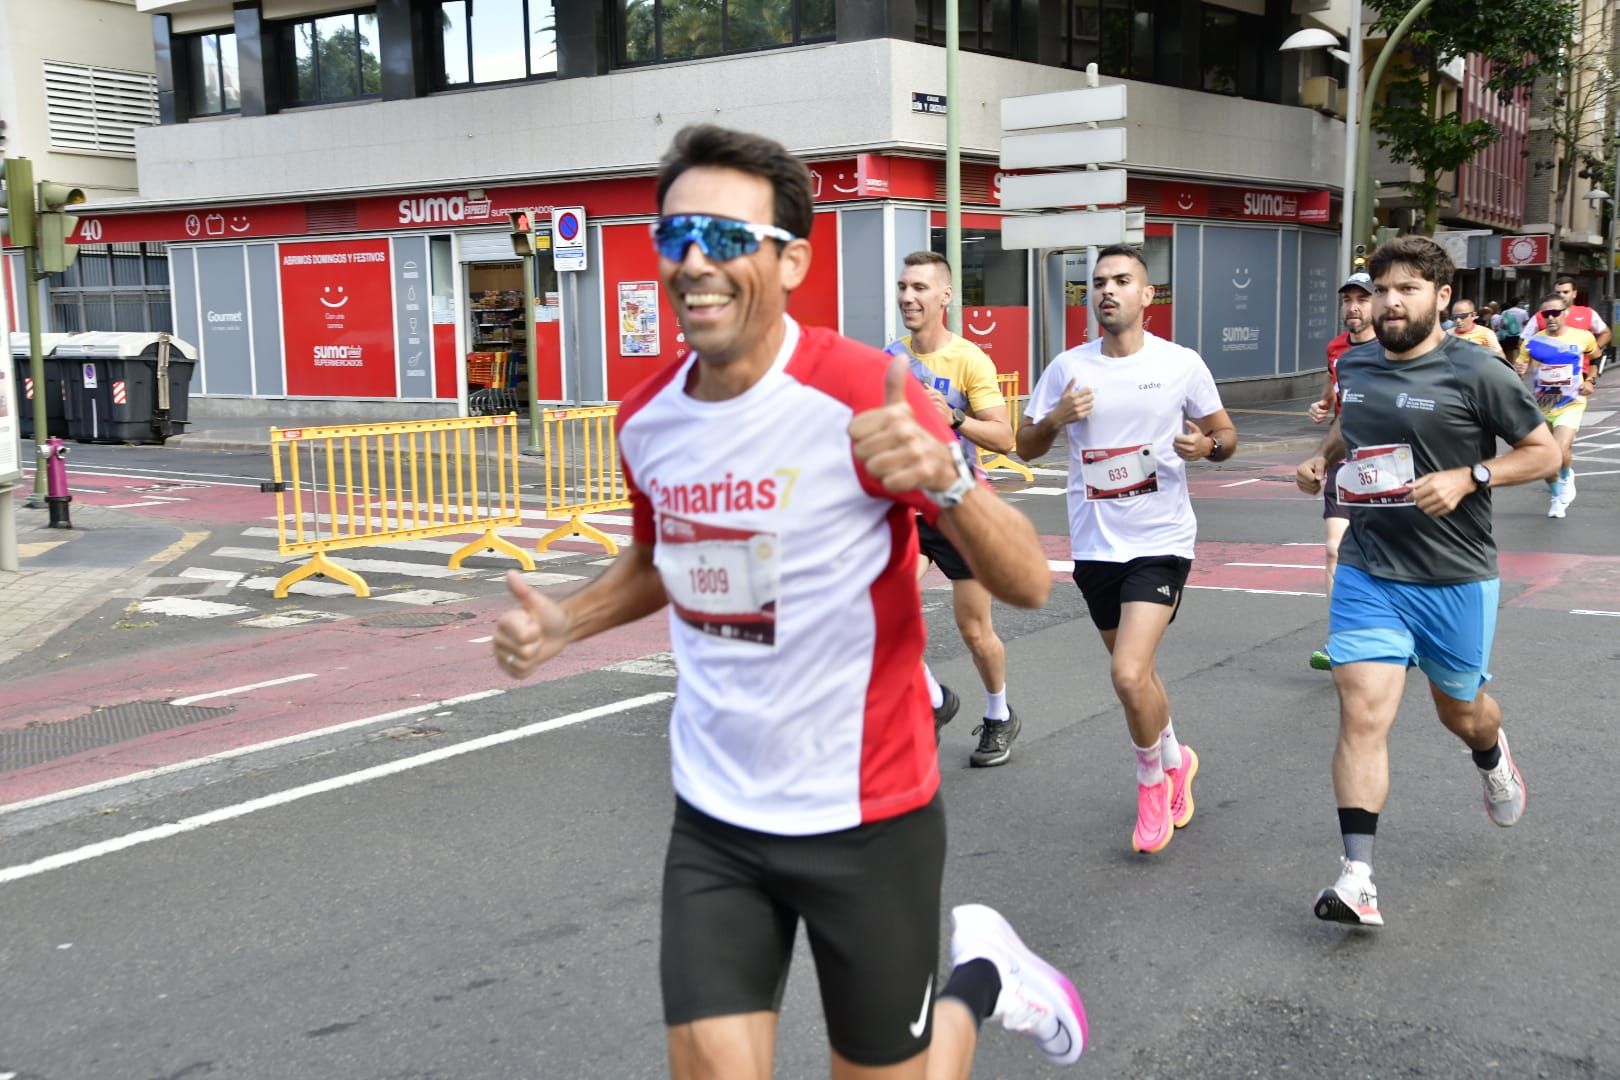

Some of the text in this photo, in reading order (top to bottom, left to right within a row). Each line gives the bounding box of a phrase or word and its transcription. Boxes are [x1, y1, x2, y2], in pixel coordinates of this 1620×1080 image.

[398, 196, 465, 224] suma
[1243, 192, 1283, 216] suma
[80, 219, 103, 241] 40
[283, 252, 385, 266] ABRIMOS DOMINGOS Y FESTIVOS
[207, 310, 243, 322] Gourmet
[1222, 326, 1250, 342] suma
[313, 345, 348, 359] suma
[313, 359, 364, 367] SUPERMERCADOS
[1107, 466, 1129, 482] 633
[1358, 469, 1379, 486] 357
[689, 568, 729, 593] 1809
